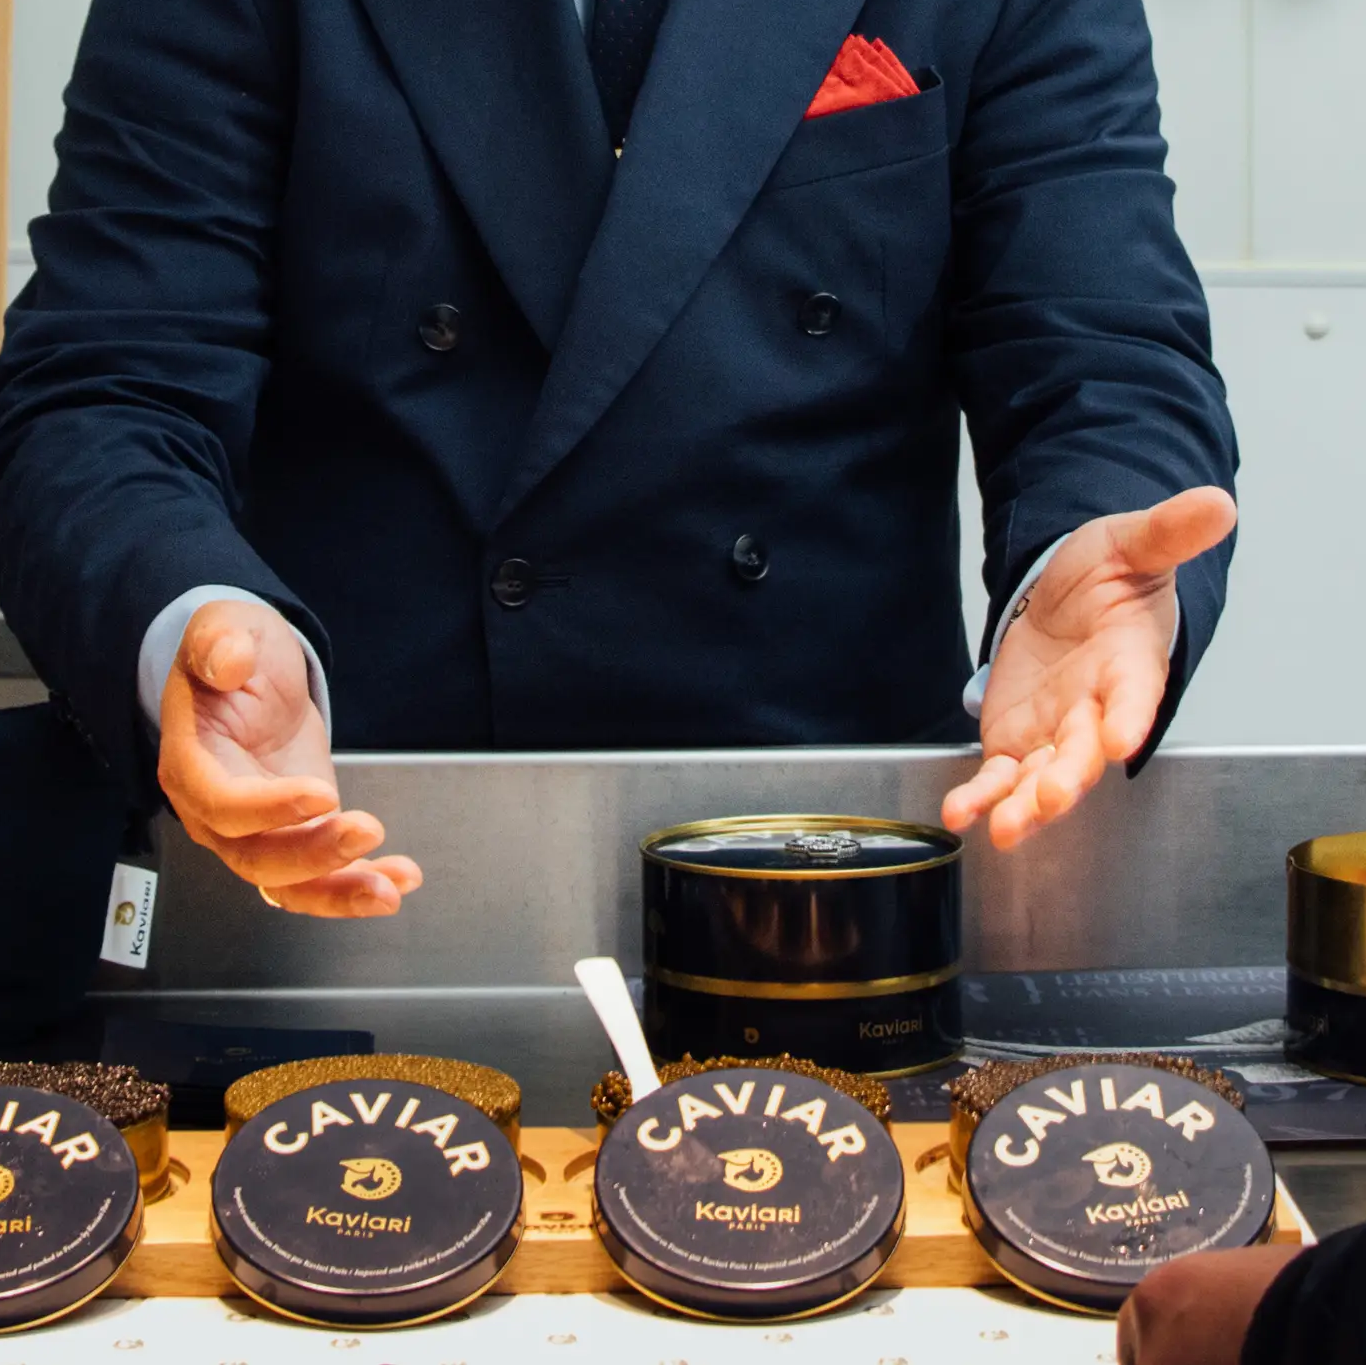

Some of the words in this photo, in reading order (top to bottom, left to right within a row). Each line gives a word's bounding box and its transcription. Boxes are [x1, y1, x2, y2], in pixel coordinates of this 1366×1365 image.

[130, 881, 151, 956] Kaviari
[859, 1013, 923, 1039] Kaviari
[263, 1092, 491, 1177] CAVIAR
[637, 1082, 866, 1162] CAVIAR
[994, 1077, 1215, 1166] CAVIAR
[306, 1206, 412, 1233] Kaviari
[695, 1200, 800, 1223] Kaviari
[1086, 1190, 1189, 1225] Kaviari
[337, 1228, 374, 1238] PARIS
[728, 1222, 766, 1231] PARIS
